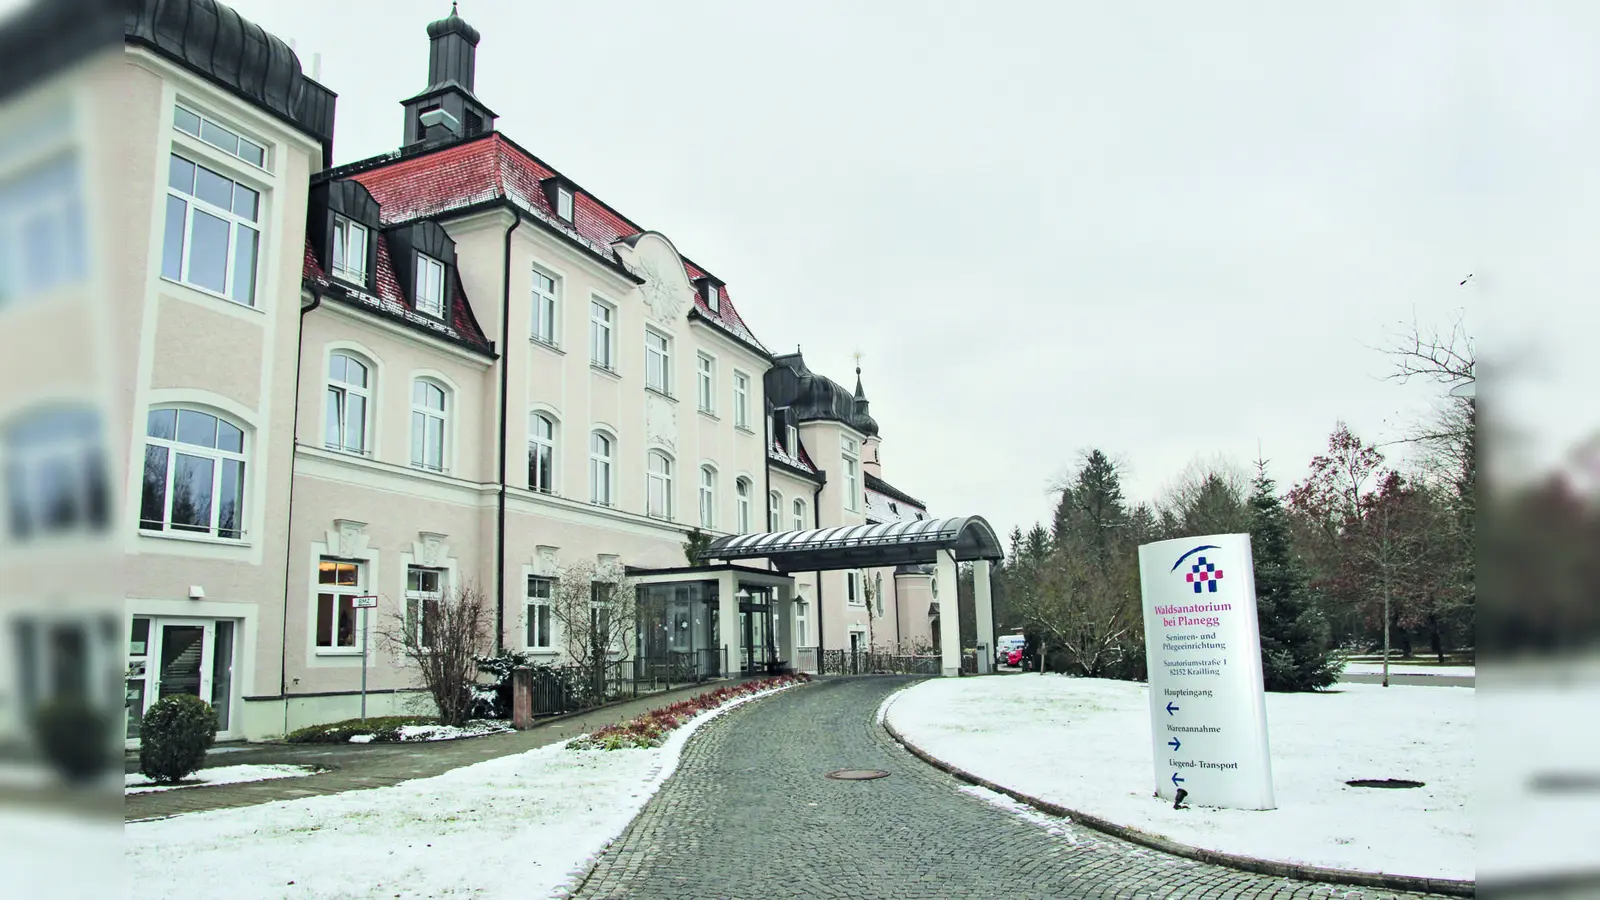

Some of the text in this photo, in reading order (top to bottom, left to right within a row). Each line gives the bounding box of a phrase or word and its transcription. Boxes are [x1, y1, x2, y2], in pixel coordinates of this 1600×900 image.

[1154, 602, 1232, 614] Waldsanatorium
[1163, 616, 1220, 626] bei Planegg
[1163, 642, 1226, 652] Pflegeeinrichtung
[1188, 668, 1220, 676] Krailling
[1164, 688, 1213, 698] Haupteingang
[1167, 724, 1221, 732] Warenannahme
[1169, 759, 1238, 770] Liegend- Transport
